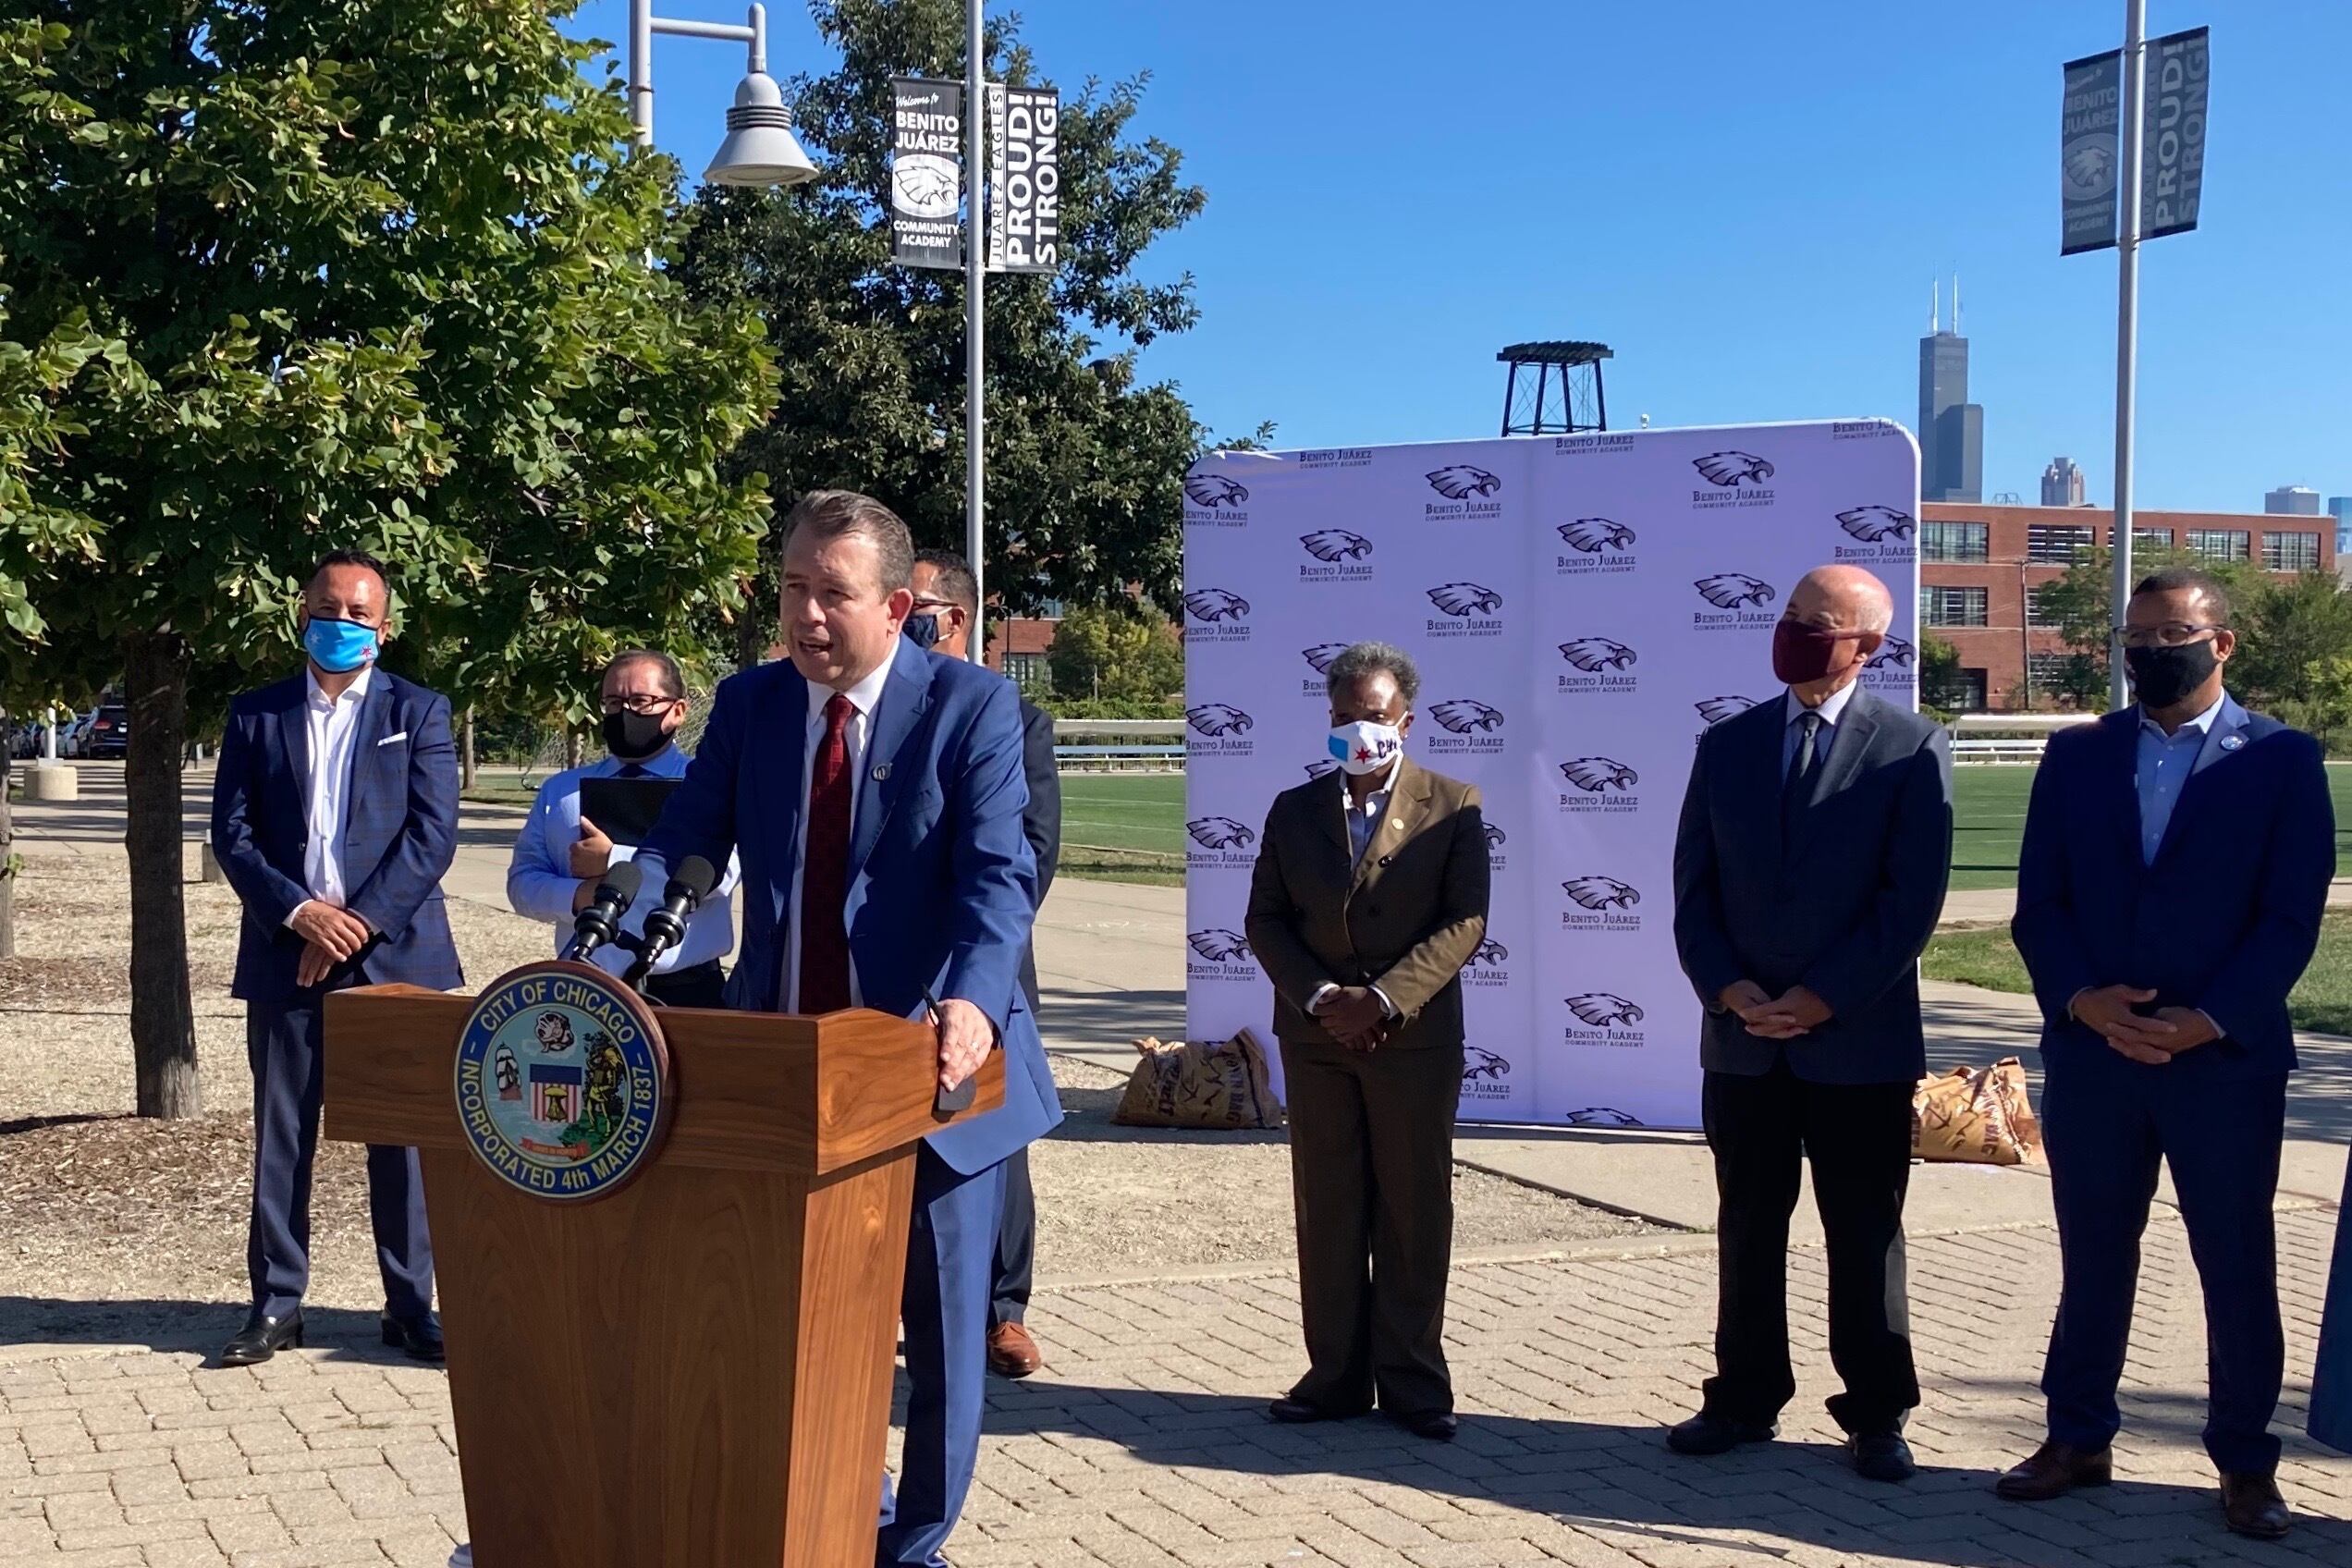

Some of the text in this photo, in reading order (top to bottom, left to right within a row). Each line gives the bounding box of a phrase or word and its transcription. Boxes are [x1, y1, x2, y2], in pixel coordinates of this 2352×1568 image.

[895, 92, 939, 108] Welcome to
[896, 111, 959, 132] BENITO
[2155, 43, 2185, 227] PROUD!
[895, 128, 959, 153] JUÁREZ
[992, 94, 1003, 260] JUAREZ EAGLES
[1007, 93, 1033, 265] PROUD!
[1035, 95, 1059, 265] STRONG!
[893, 220, 959, 235] COMMUNITY
[900, 235, 951, 248] ACADEMY
[1832, 423, 1873, 433] BENITO
[1556, 437, 1593, 447] BENITO
[1300, 452, 1334, 461] BENITO
[1693, 491, 1732, 501] BENITO
[1426, 504, 1462, 514] BENITO
[1186, 510, 1211, 520] ENITO
[1835, 546, 1875, 557] BENITO
[1557, 557, 1595, 567] BENITO
[1300, 565, 1335, 575] BENITO
[1694, 613, 1733, 623] BENITO
[1427, 620, 1463, 630] BENITO
[1303, 680, 1325, 690] BENI
[1559, 676, 1596, 686] BENITO
[1429, 737, 1464, 747] BENITO
[1561, 794, 1598, 804] BENITO
[1186, 851, 1219, 862] BENITO
[1562, 913, 1599, 923] BENITO
[1187, 963, 1219, 974] BENITO
[480, 981, 634, 1044] CITY OF CHICAGO
[1565, 1028, 1602, 1039] BENITO
[462, 1059, 652, 1190] INCORPORATED 4th MARCH 1837
